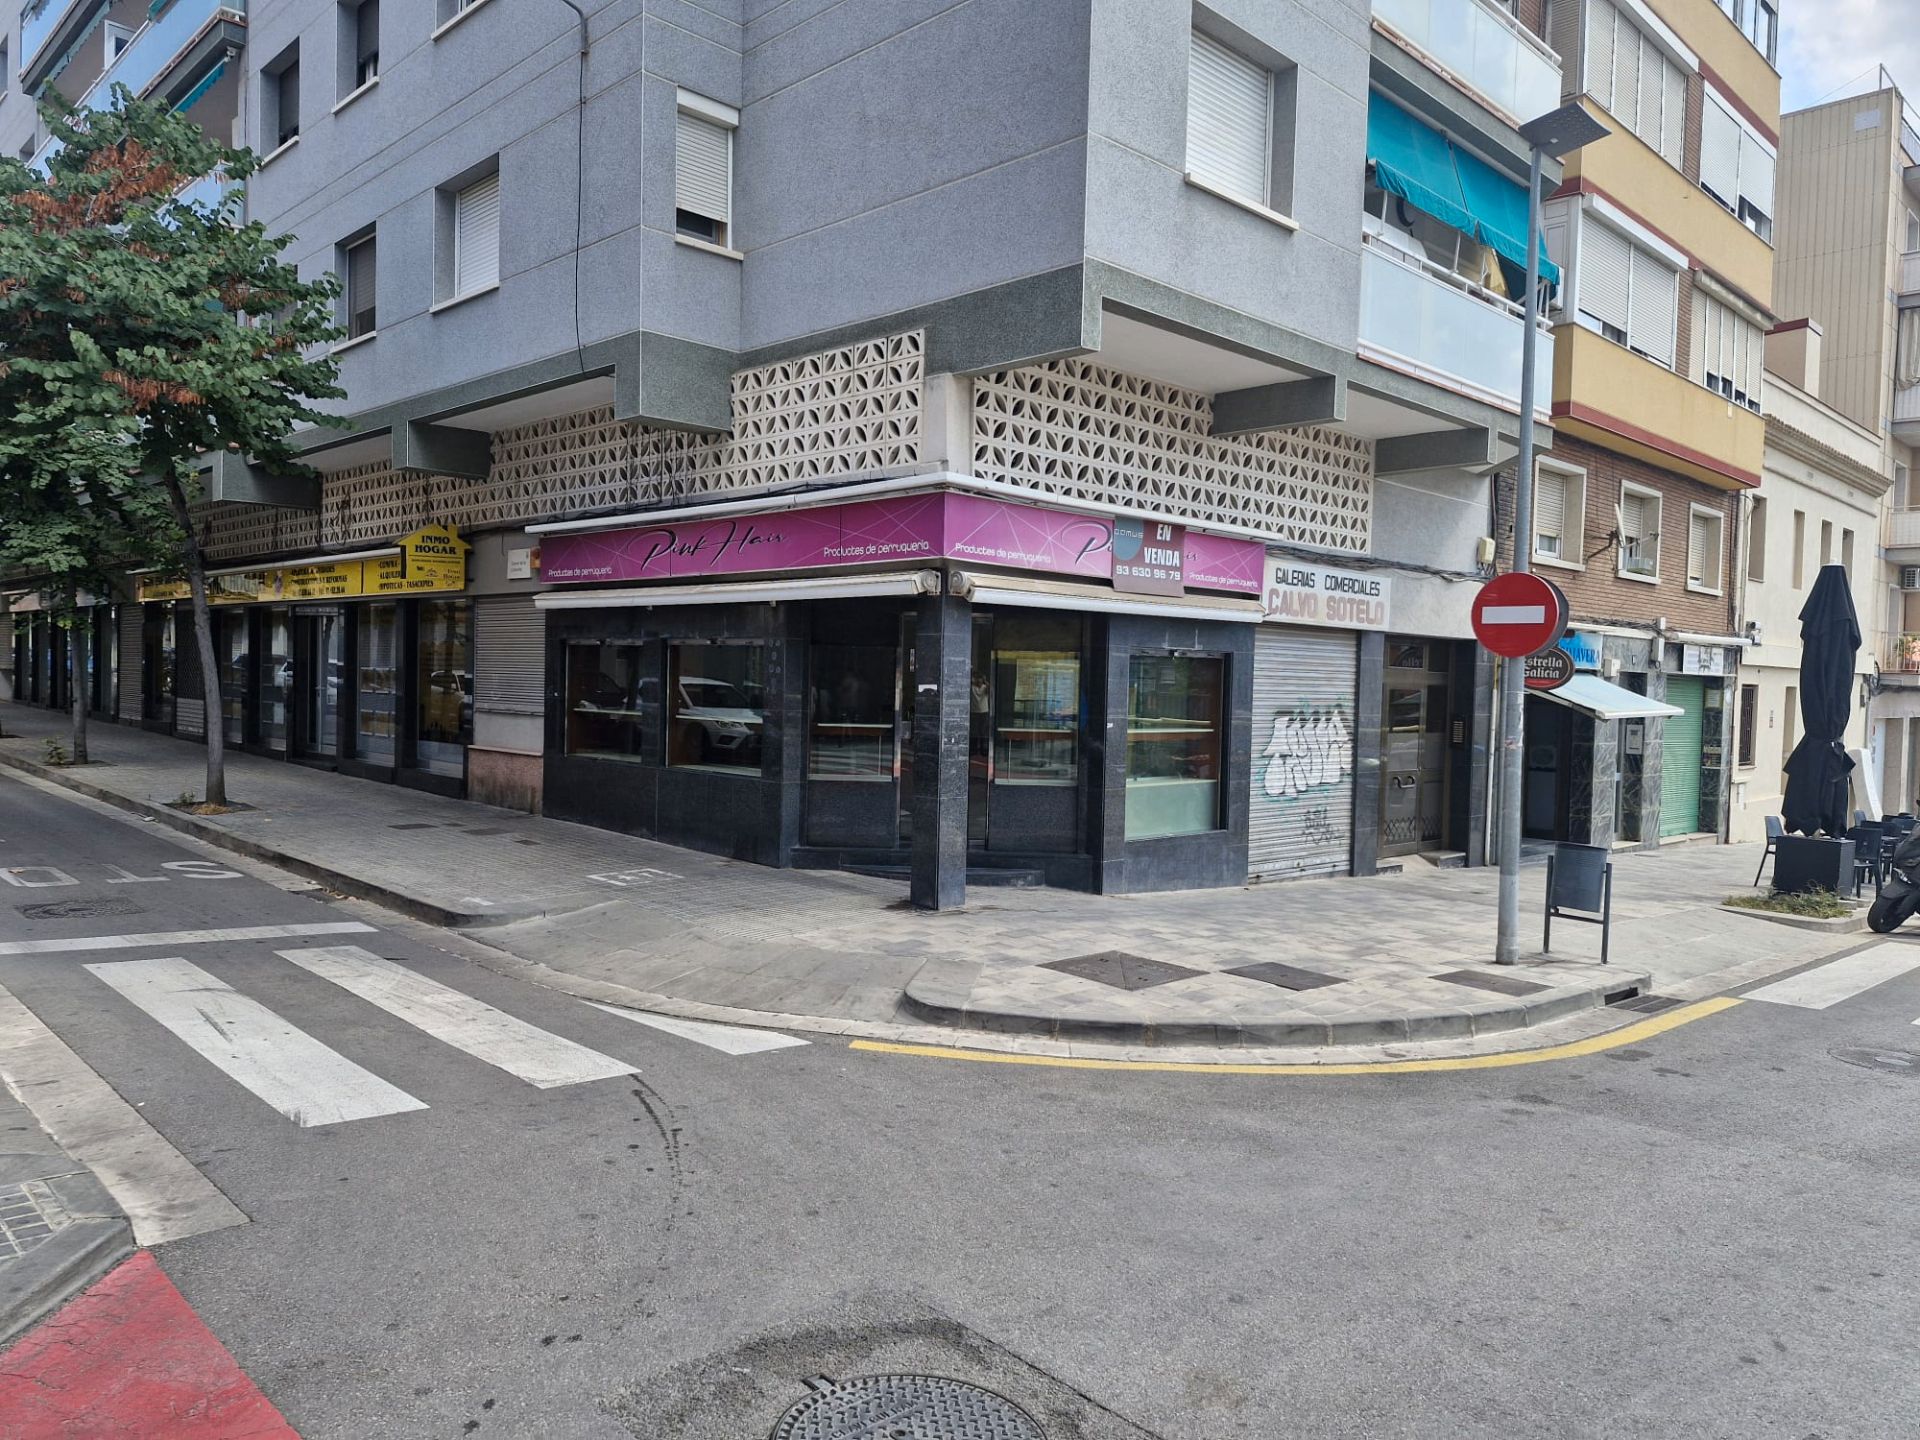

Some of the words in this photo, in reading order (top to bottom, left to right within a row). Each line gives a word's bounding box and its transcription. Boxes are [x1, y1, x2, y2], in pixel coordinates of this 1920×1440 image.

[421, 535, 450, 544] INMO
[1156, 523, 1172, 541] EN
[415, 544, 457, 555] HOGAR
[626, 528, 710, 571] Pink
[823, 545, 864, 557] Productes
[865, 543, 876, 554] de
[955, 542, 995, 557] Productes
[996, 548, 1006, 558] de
[1144, 546, 1180, 568] VENDA
[548, 568, 573, 577] Productes
[574, 568, 580, 577] de
[1116, 565, 1129, 575] 93
[1132, 566, 1151, 577] 630
[1169, 570, 1181, 581] 79
[1190, 572, 1218, 583] Productes
[1275, 567, 1316, 589] GALERIAS
[1324, 574, 1380, 597] COMERCIALES
[1268, 587, 1319, 618] CALVO
[1325, 595, 1385, 625] SOTELO
[0, 860, 244, 887] STO
